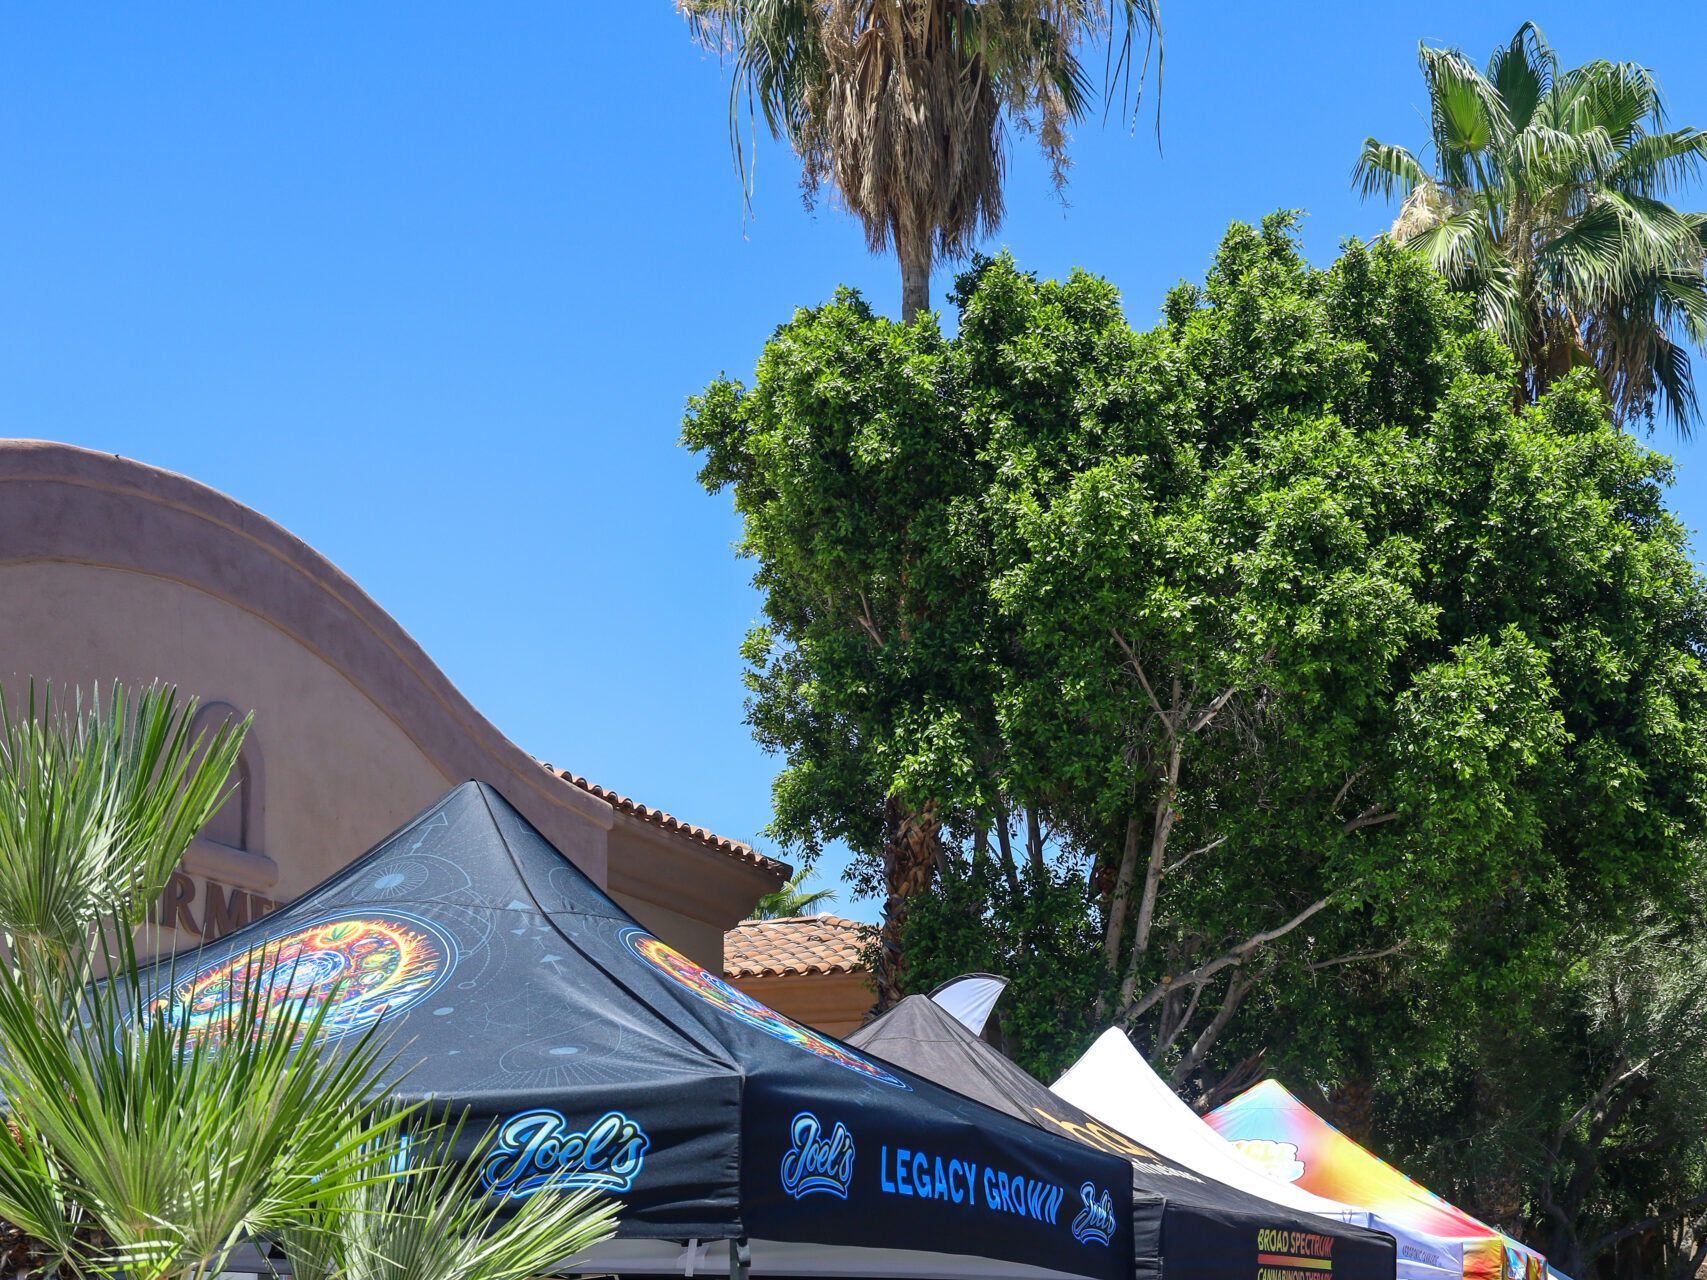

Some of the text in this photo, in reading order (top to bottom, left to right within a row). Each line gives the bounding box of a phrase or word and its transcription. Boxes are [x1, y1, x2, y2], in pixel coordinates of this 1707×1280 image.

[482, 1109, 650, 1199] Joel's
[781, 1112, 855, 1199] Joel's
[880, 1145, 1065, 1226] LEGACY GROWN
[1071, 1181, 1117, 1247] Joel's
[1257, 1228, 1335, 1257] BROAD SPECTRUM
